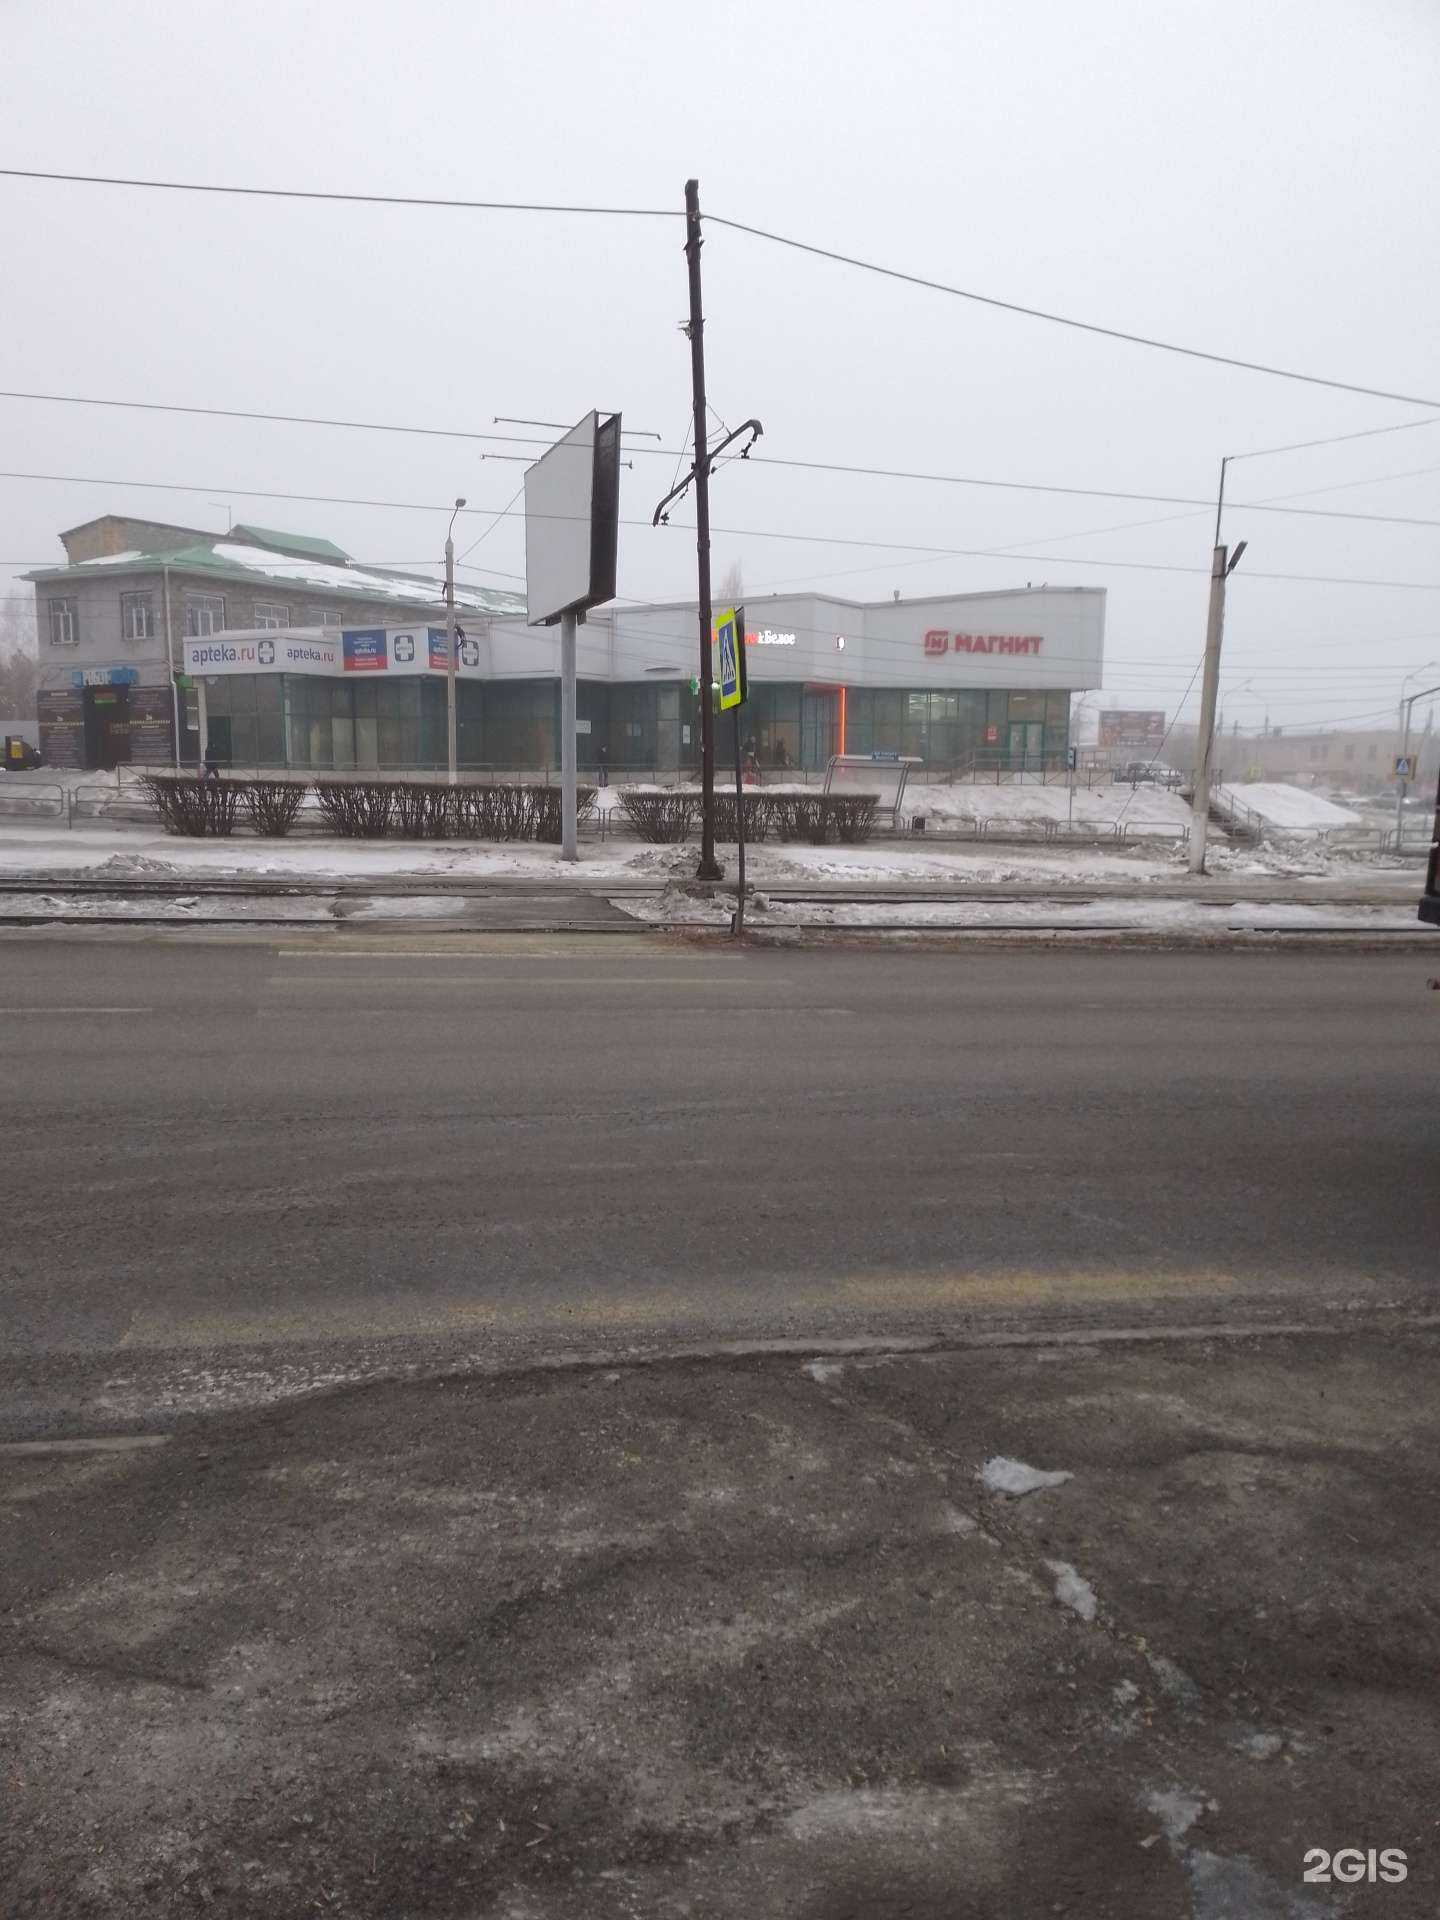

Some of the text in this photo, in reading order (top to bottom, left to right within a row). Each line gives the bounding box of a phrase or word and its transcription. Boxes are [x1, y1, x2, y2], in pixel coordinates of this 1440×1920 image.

[192, 643, 255, 665] apteka.ru
[287, 647, 334, 662] apteka.ru
[955, 633, 1044, 655] МАГНИТ
